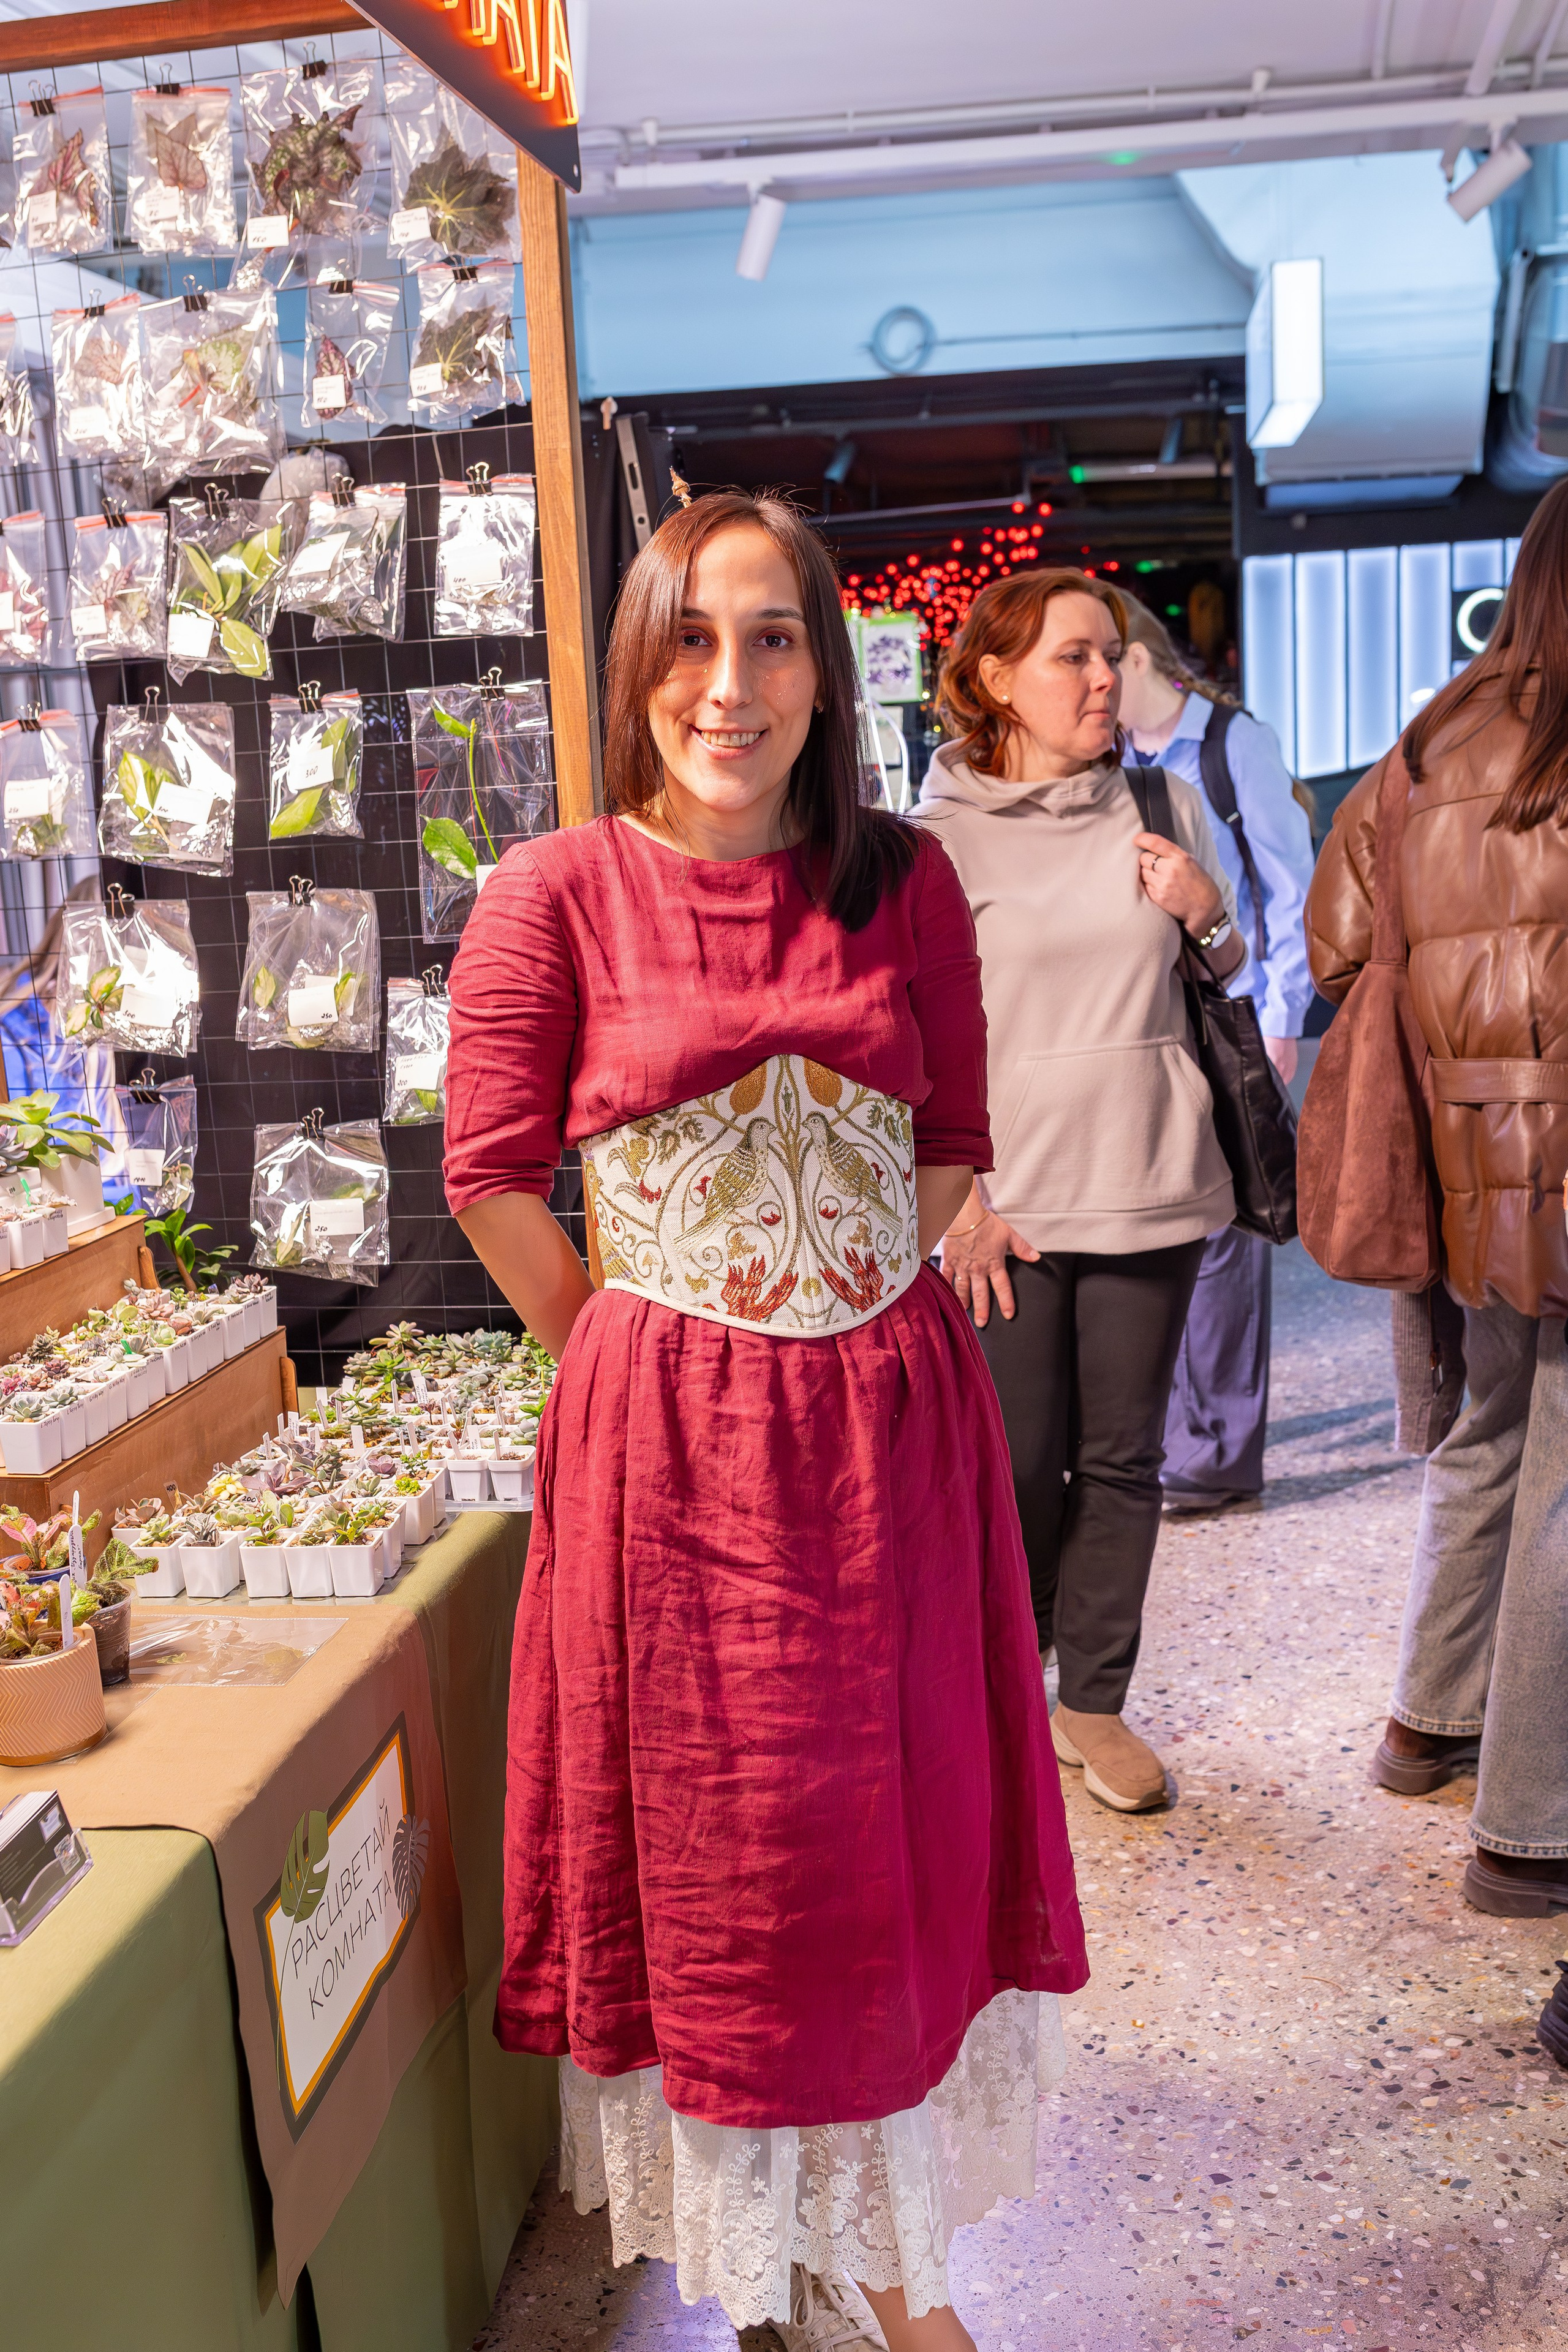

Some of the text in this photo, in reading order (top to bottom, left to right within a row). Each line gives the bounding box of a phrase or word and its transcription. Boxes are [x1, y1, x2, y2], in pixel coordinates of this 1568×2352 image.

[305, 765, 318, 778] 300
[166, 1483, 176, 1493] 400
[290, 1798, 391, 1979] РАСЦВЕТАЙ
[307, 1869, 392, 2021] КОМНАТА
